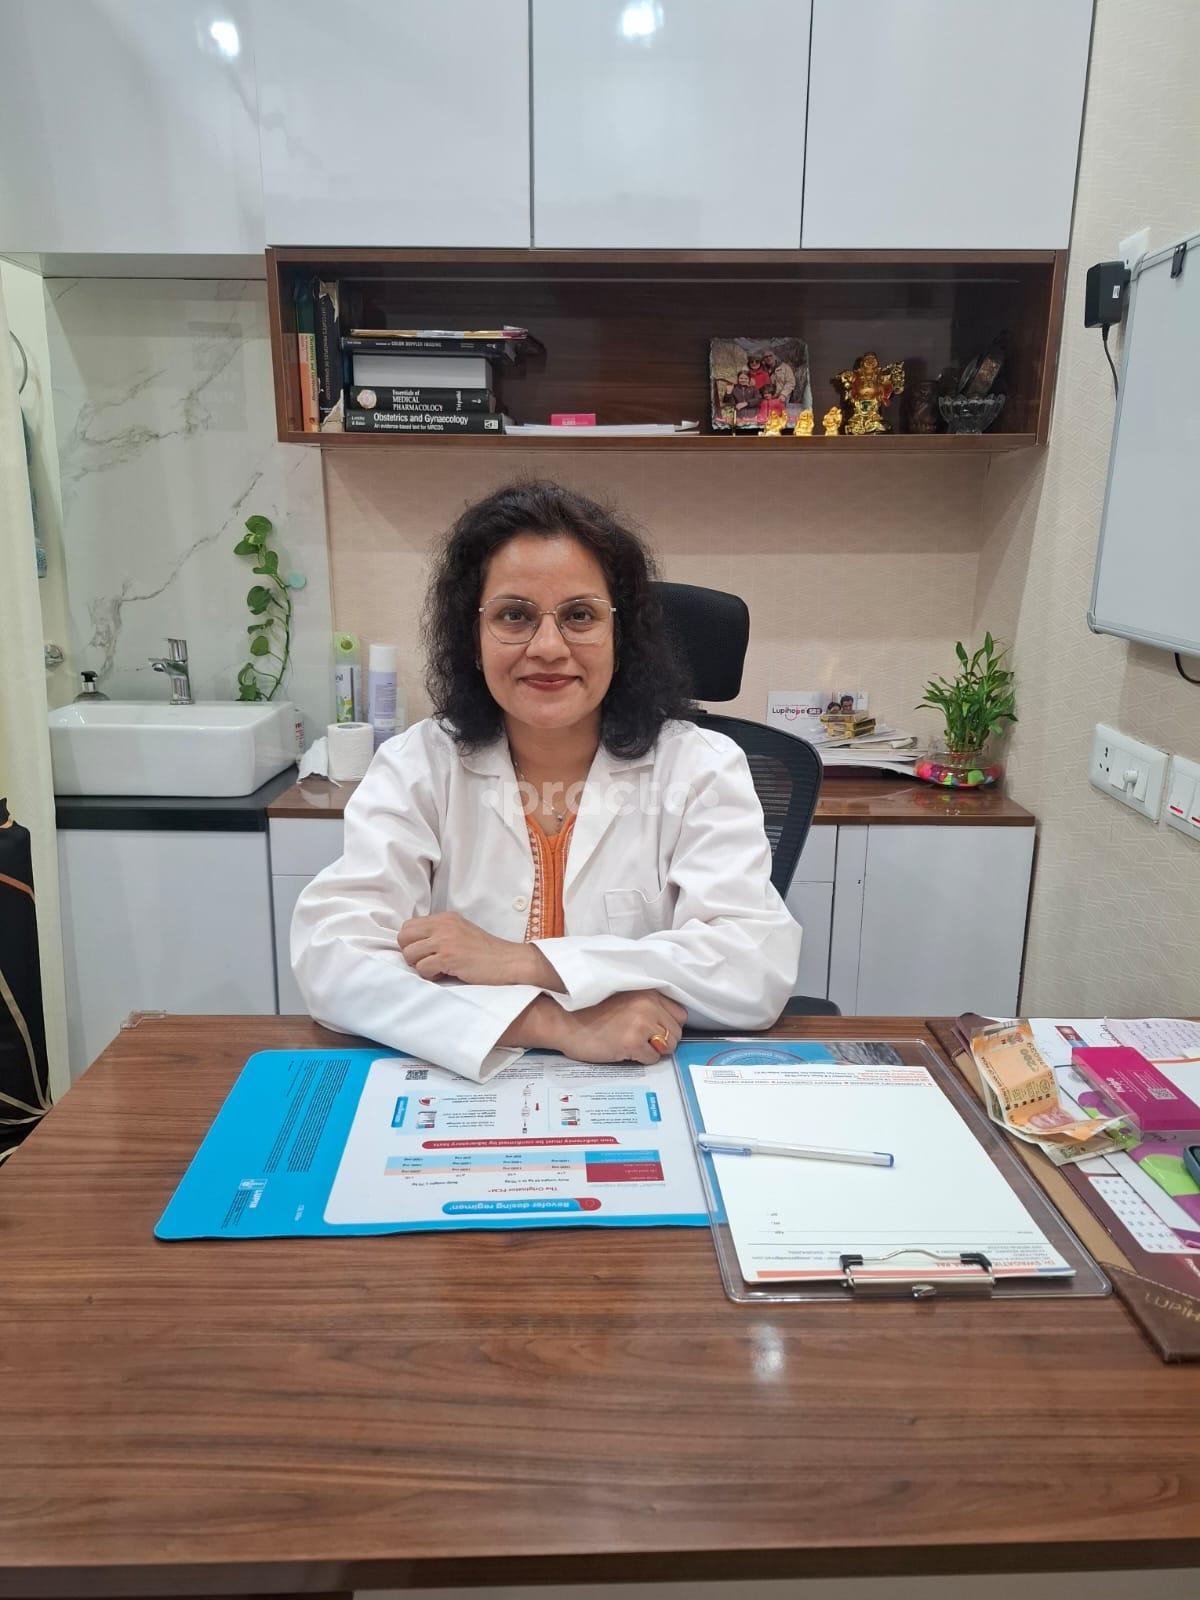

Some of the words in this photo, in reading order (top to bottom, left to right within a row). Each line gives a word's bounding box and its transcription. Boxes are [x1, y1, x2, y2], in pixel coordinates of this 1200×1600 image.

[373, 412, 408, 423] Obstetrics
[409, 414, 423, 423] and
[424, 414, 468, 426] Gynaecology
[496, 1201, 531, 1210] dosing
[532, 1201, 570, 1209] Revofer
